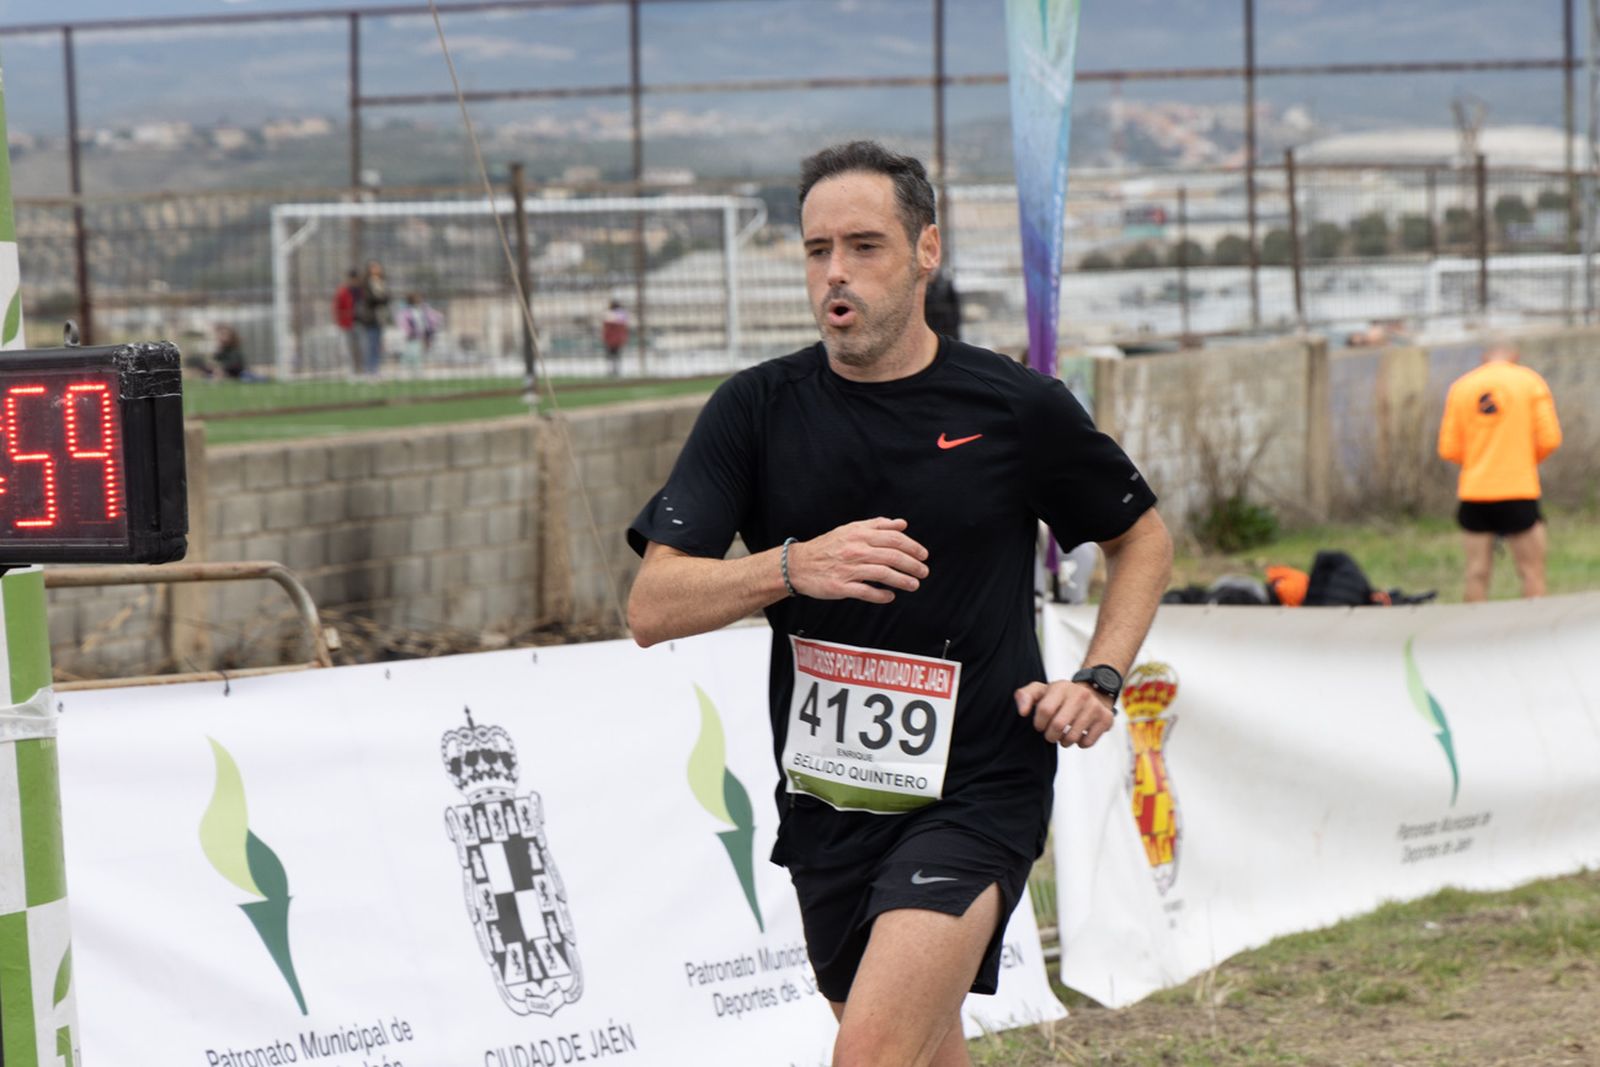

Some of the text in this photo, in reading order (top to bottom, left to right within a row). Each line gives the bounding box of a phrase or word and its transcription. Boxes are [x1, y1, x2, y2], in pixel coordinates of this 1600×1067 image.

[834, 653, 878, 683] POPULAR
[877, 659, 911, 688] CIUDAD
[910, 665, 926, 690] DE
[799, 681, 937, 756] 4139
[793, 753, 928, 790] BELLIDO QUINTERO
[836, 748, 874, 762] ENRIQUE
[685, 953, 756, 987] Patronato
[713, 987, 779, 1019] Deportes
[780, 978, 801, 1003] de
[205, 1016, 414, 1067] Patronato Municipal de
[484, 1018, 637, 1067] CIUDAD DE JAÉN
